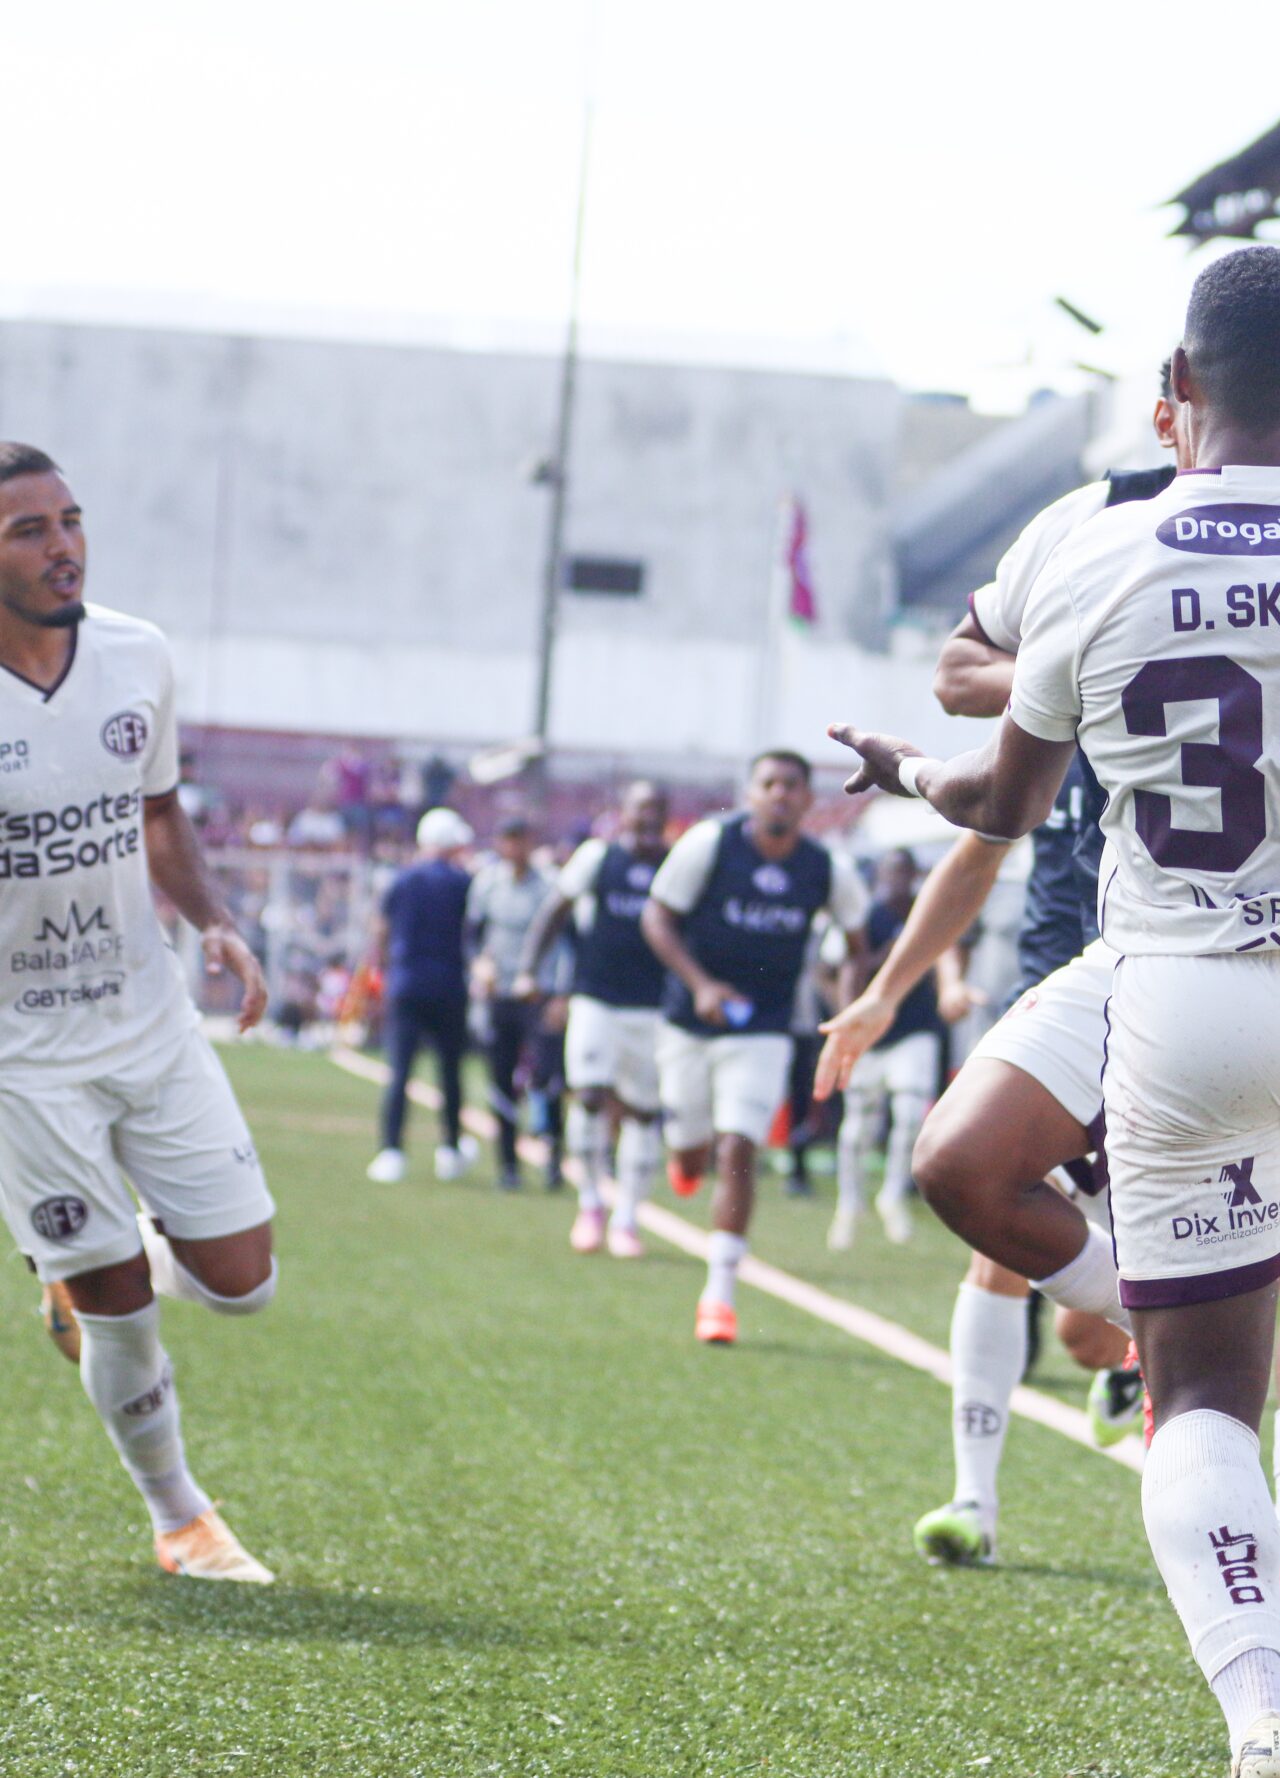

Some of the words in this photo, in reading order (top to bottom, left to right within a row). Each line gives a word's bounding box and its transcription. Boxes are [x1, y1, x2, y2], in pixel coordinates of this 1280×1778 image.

[1171, 588, 1215, 632] D.
[45, 827, 138, 876] Sorte
[1172, 1212, 1221, 1240] Dix
[1195, 1223, 1273, 1247] Securitizadora
[1207, 1525, 1265, 1605] LUPO
